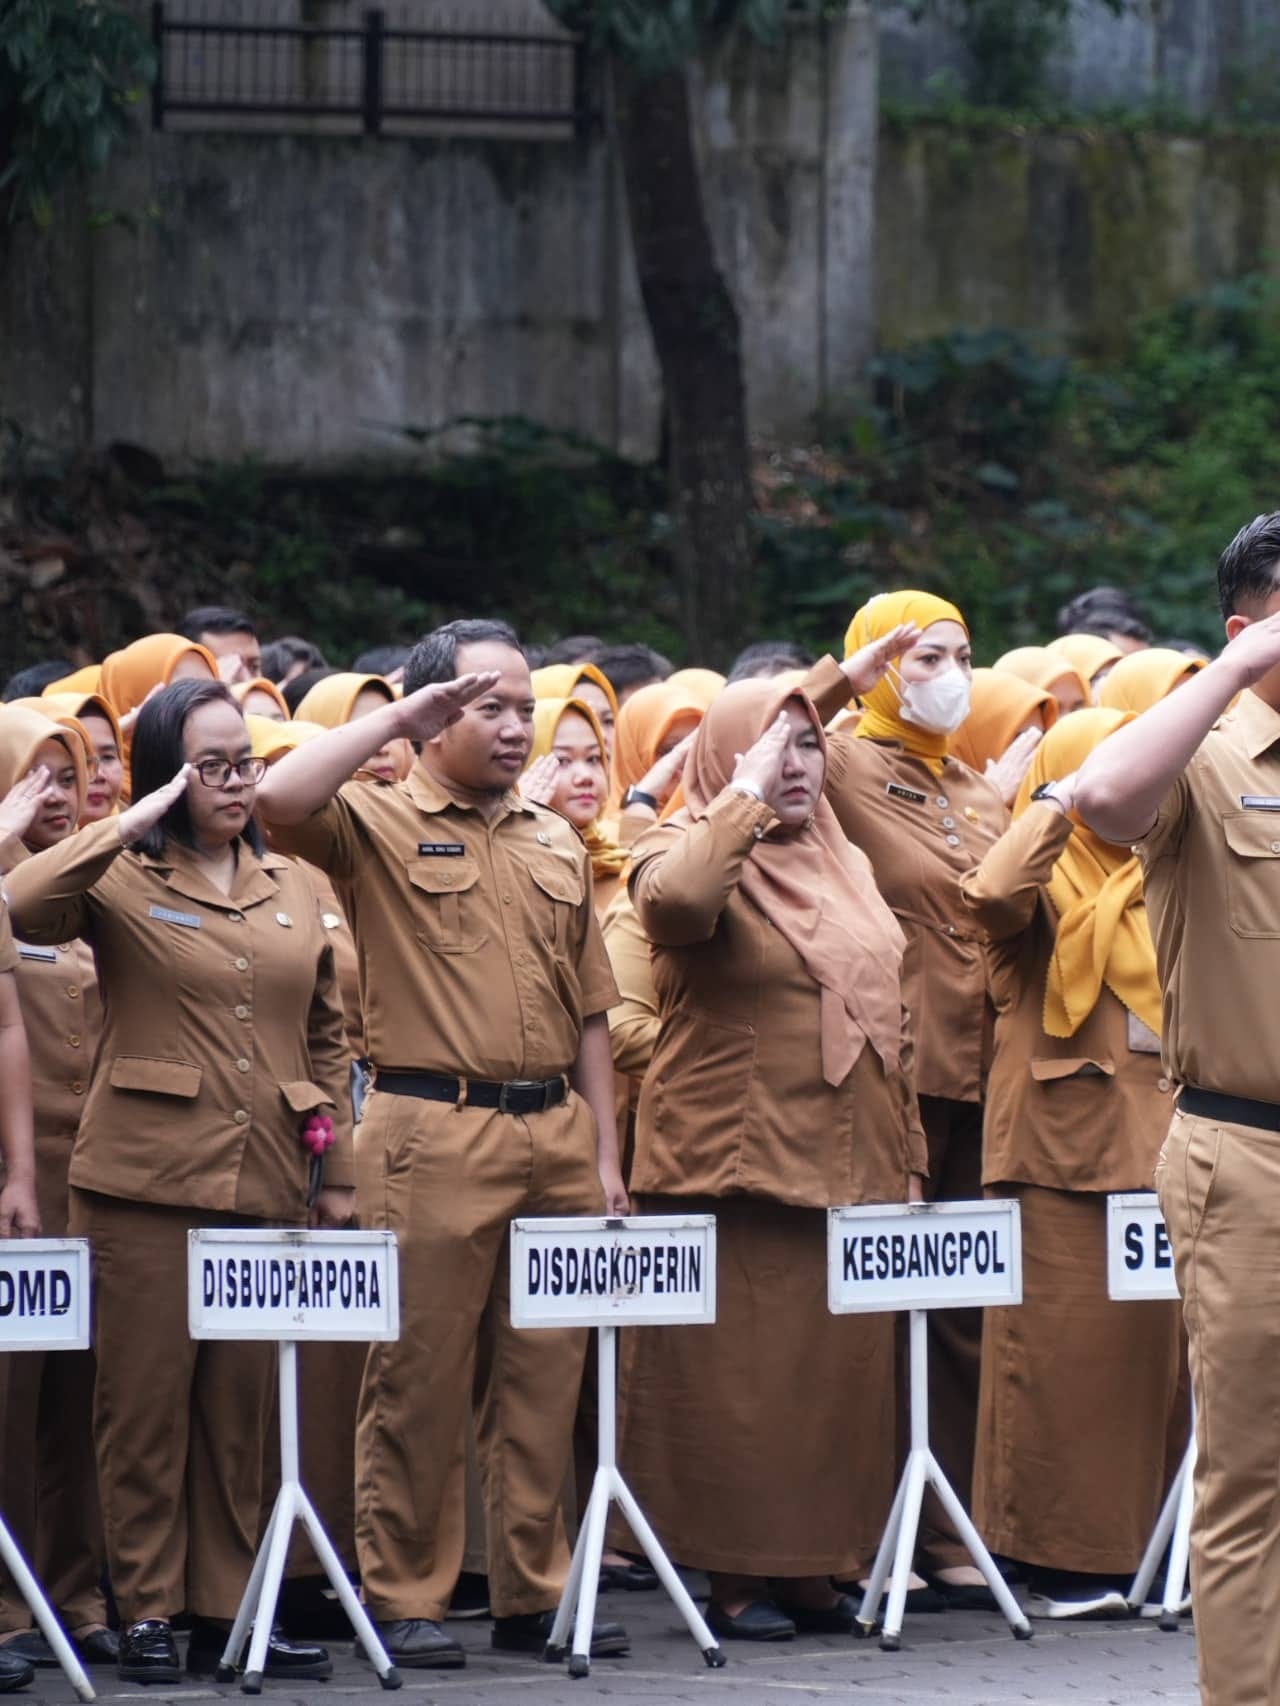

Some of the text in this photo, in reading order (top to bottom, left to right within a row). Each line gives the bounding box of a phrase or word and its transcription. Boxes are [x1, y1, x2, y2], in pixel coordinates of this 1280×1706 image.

[528, 1246, 701, 1296] DISDAGKOPERIN
[843, 1230, 1005, 1281] KESBANGPOL
[203, 1258, 381, 1309] DISBUDPARPORA
